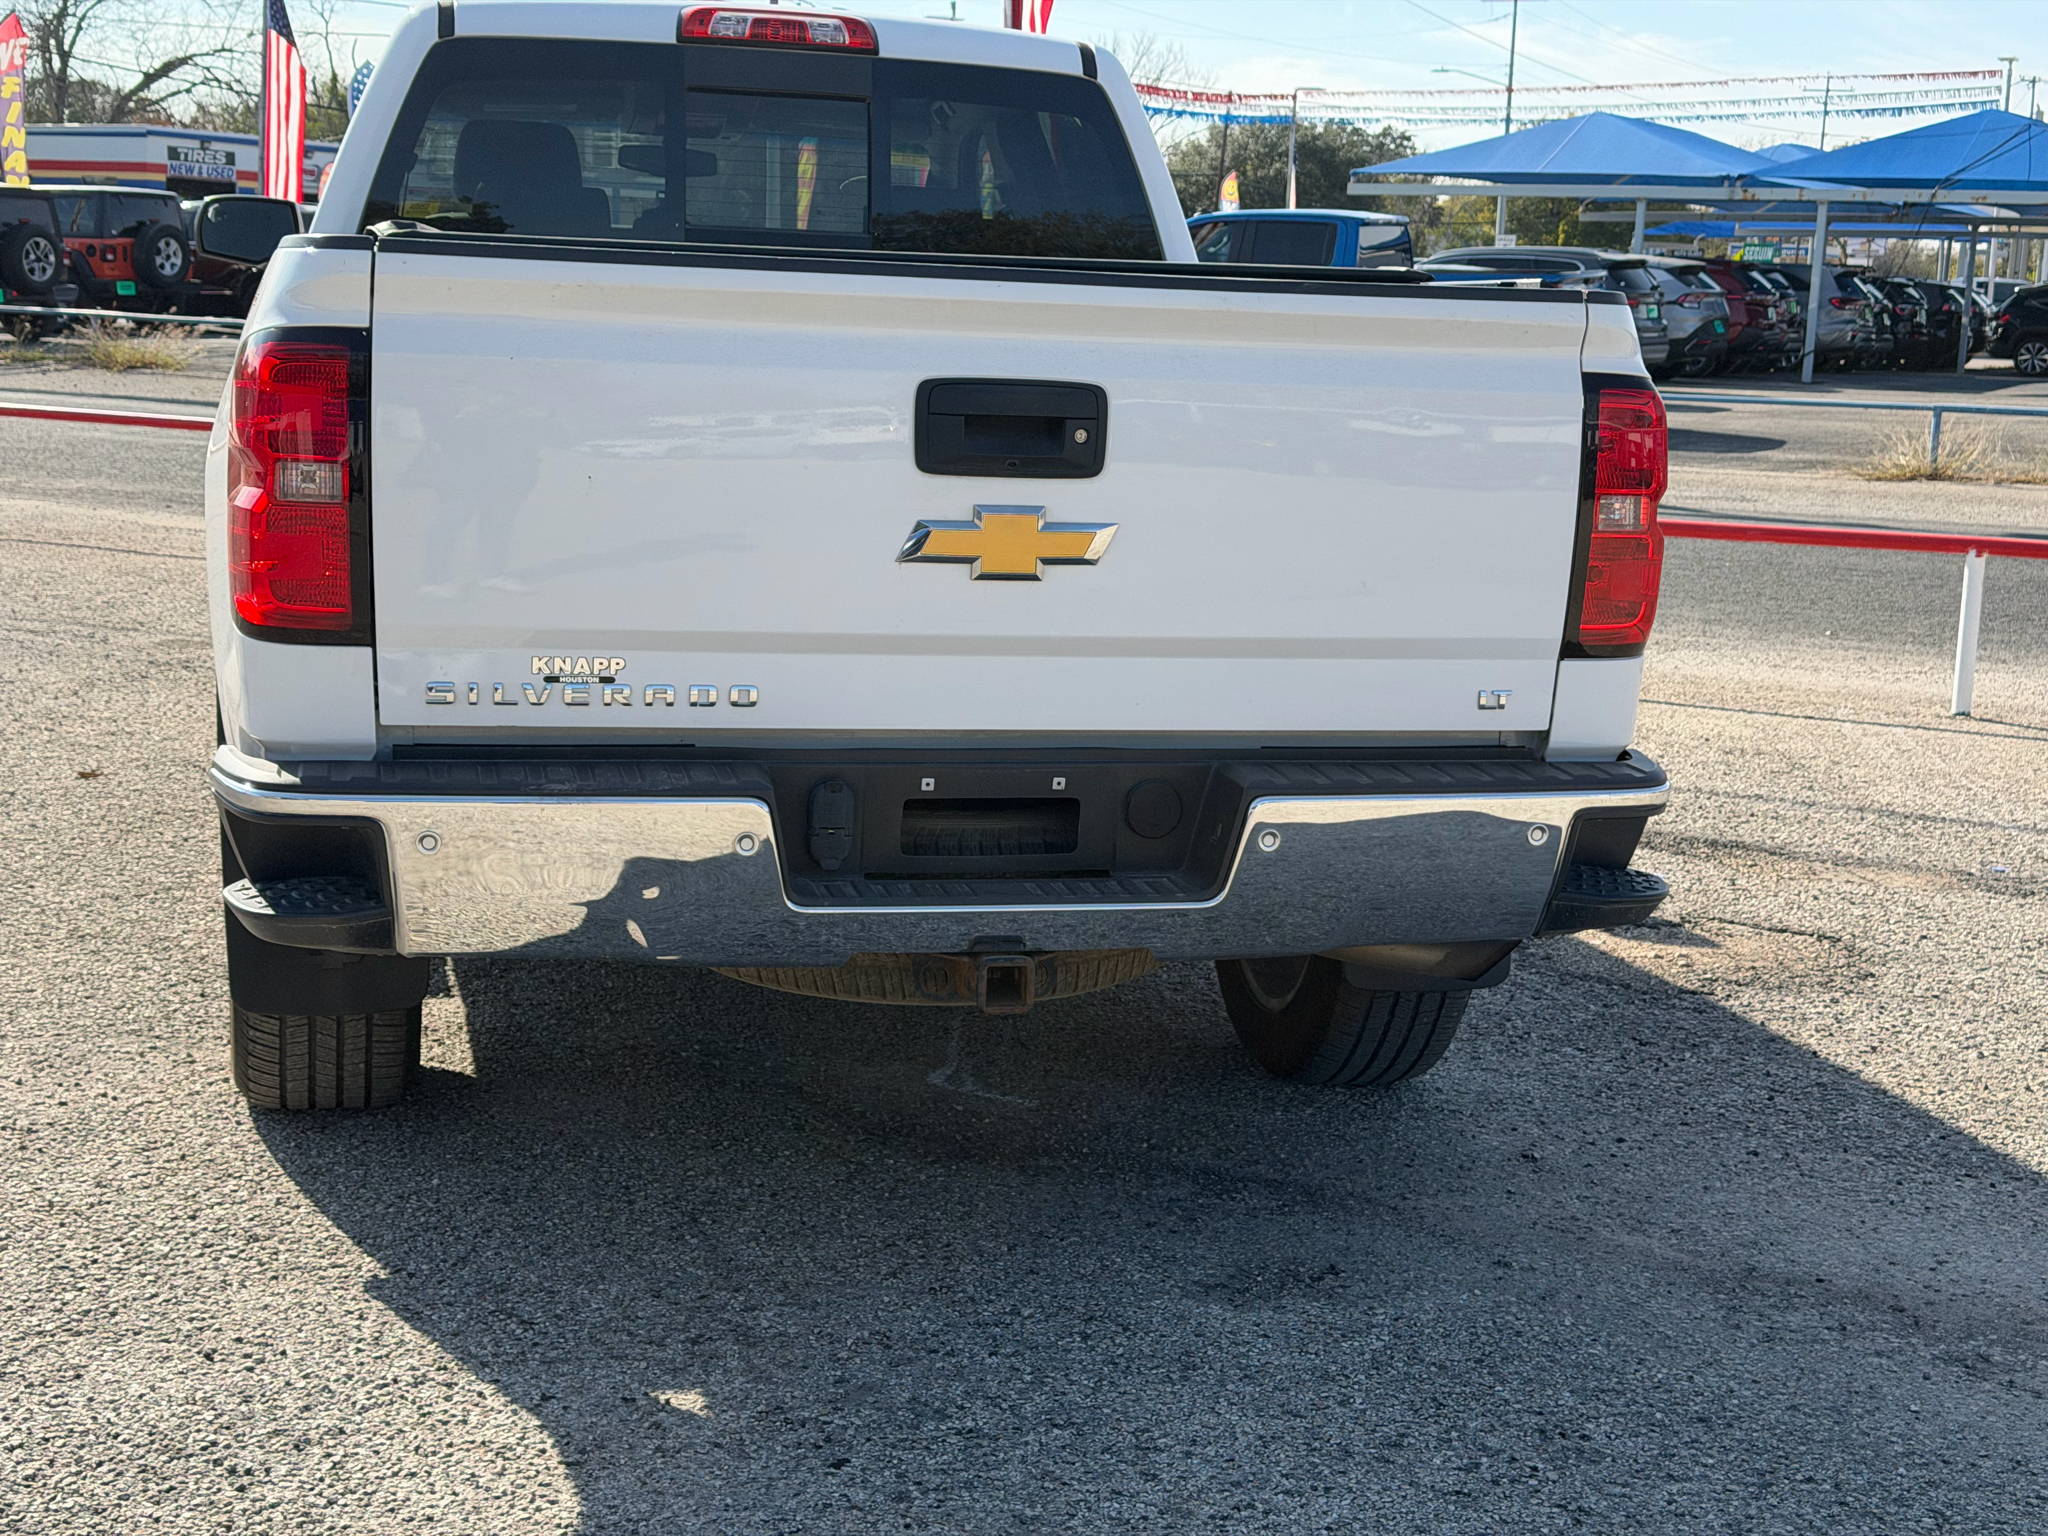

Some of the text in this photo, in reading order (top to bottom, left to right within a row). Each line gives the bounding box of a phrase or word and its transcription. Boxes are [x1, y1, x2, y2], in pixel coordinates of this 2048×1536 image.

[177, 148, 226, 164] TIRES
[169, 162, 195, 175] NEW
[206, 166, 234, 178] USED
[531, 656, 626, 675] KNAPP
[425, 681, 759, 707] SILVERADO
[1478, 690, 1513, 710] LT
